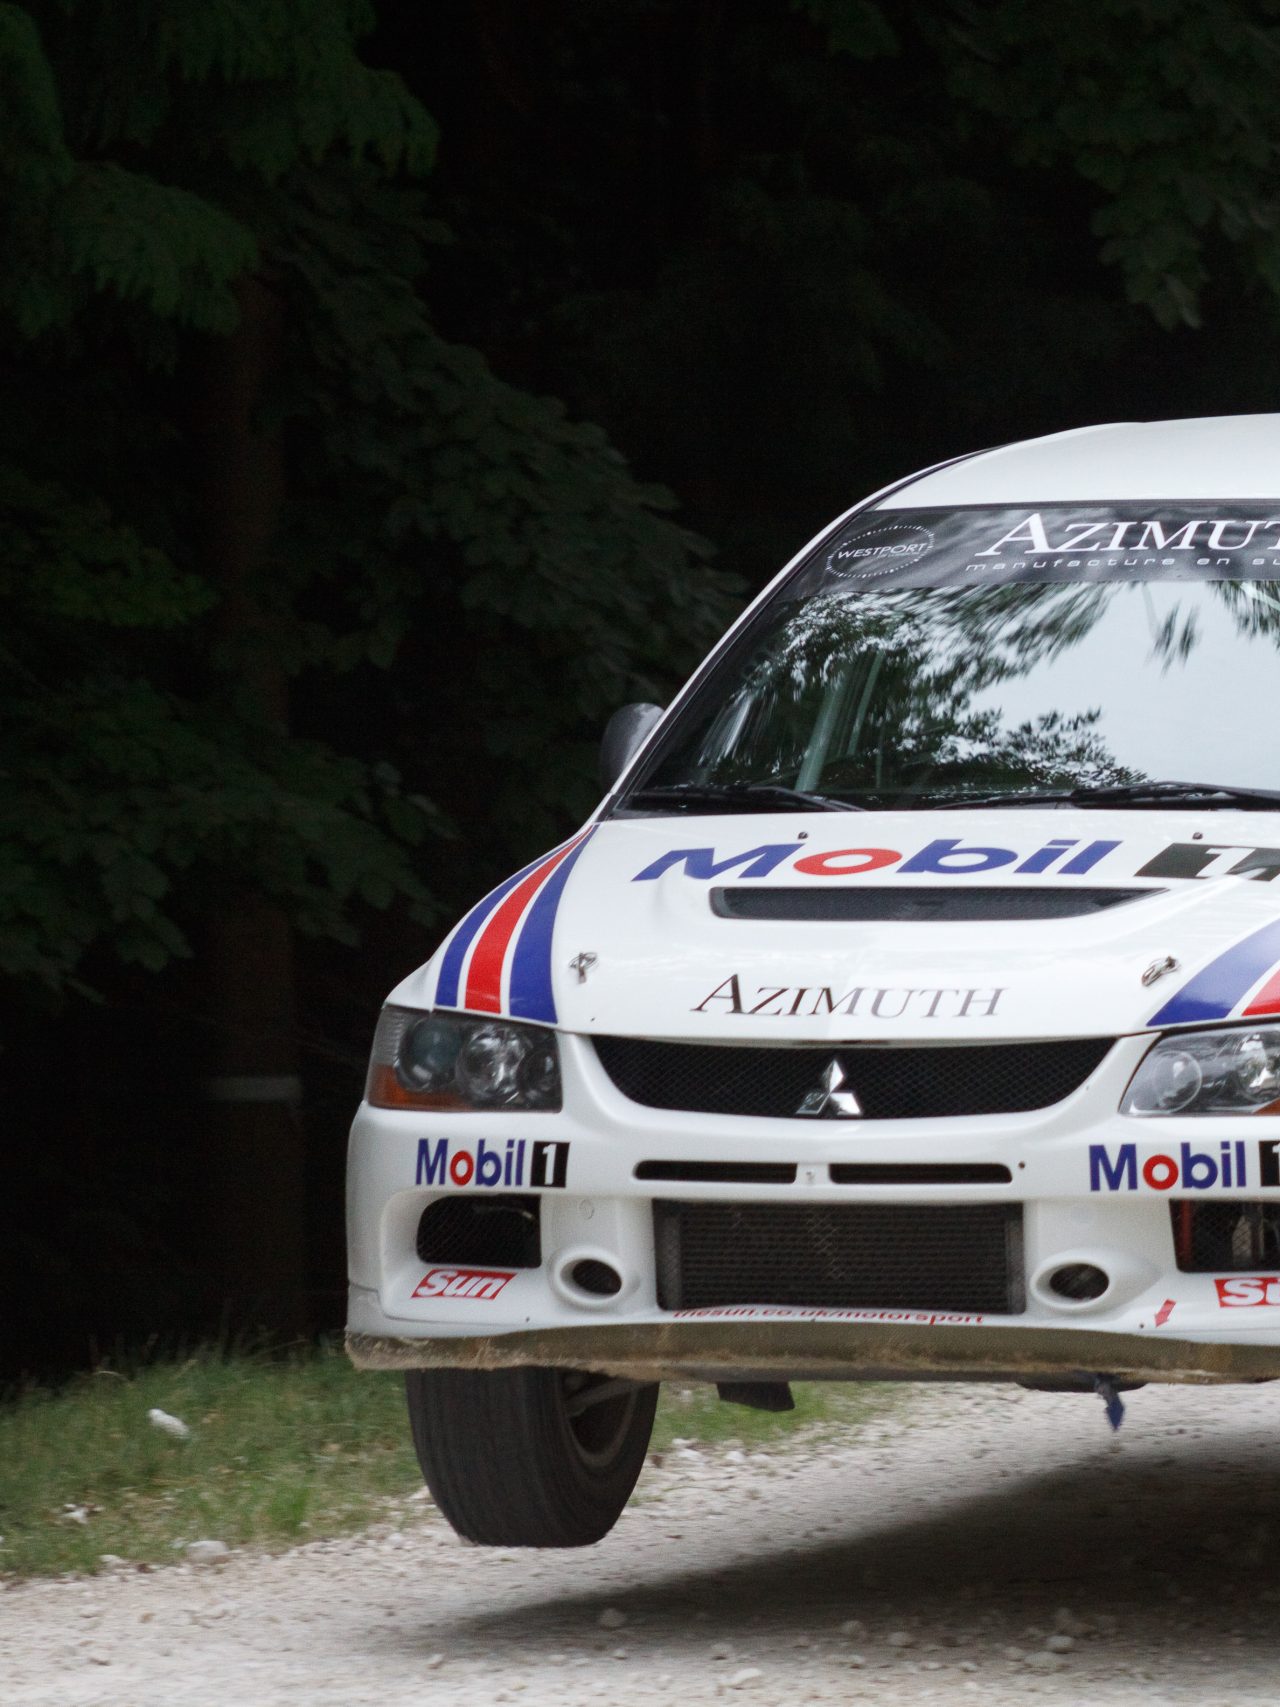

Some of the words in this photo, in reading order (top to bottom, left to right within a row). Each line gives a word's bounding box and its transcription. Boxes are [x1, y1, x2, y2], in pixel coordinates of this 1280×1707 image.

[837, 543, 928, 559] WESTPORT
[965, 557, 1175, 571] manufacture
[1196, 558, 1230, 566] en
[631, 839, 1123, 881] Mobil
[690, 973, 1009, 1018] AZIMUTH
[416, 1138, 526, 1187] Mobil
[1089, 1140, 1246, 1191] Mobil
[416, 1270, 507, 1298] Sun
